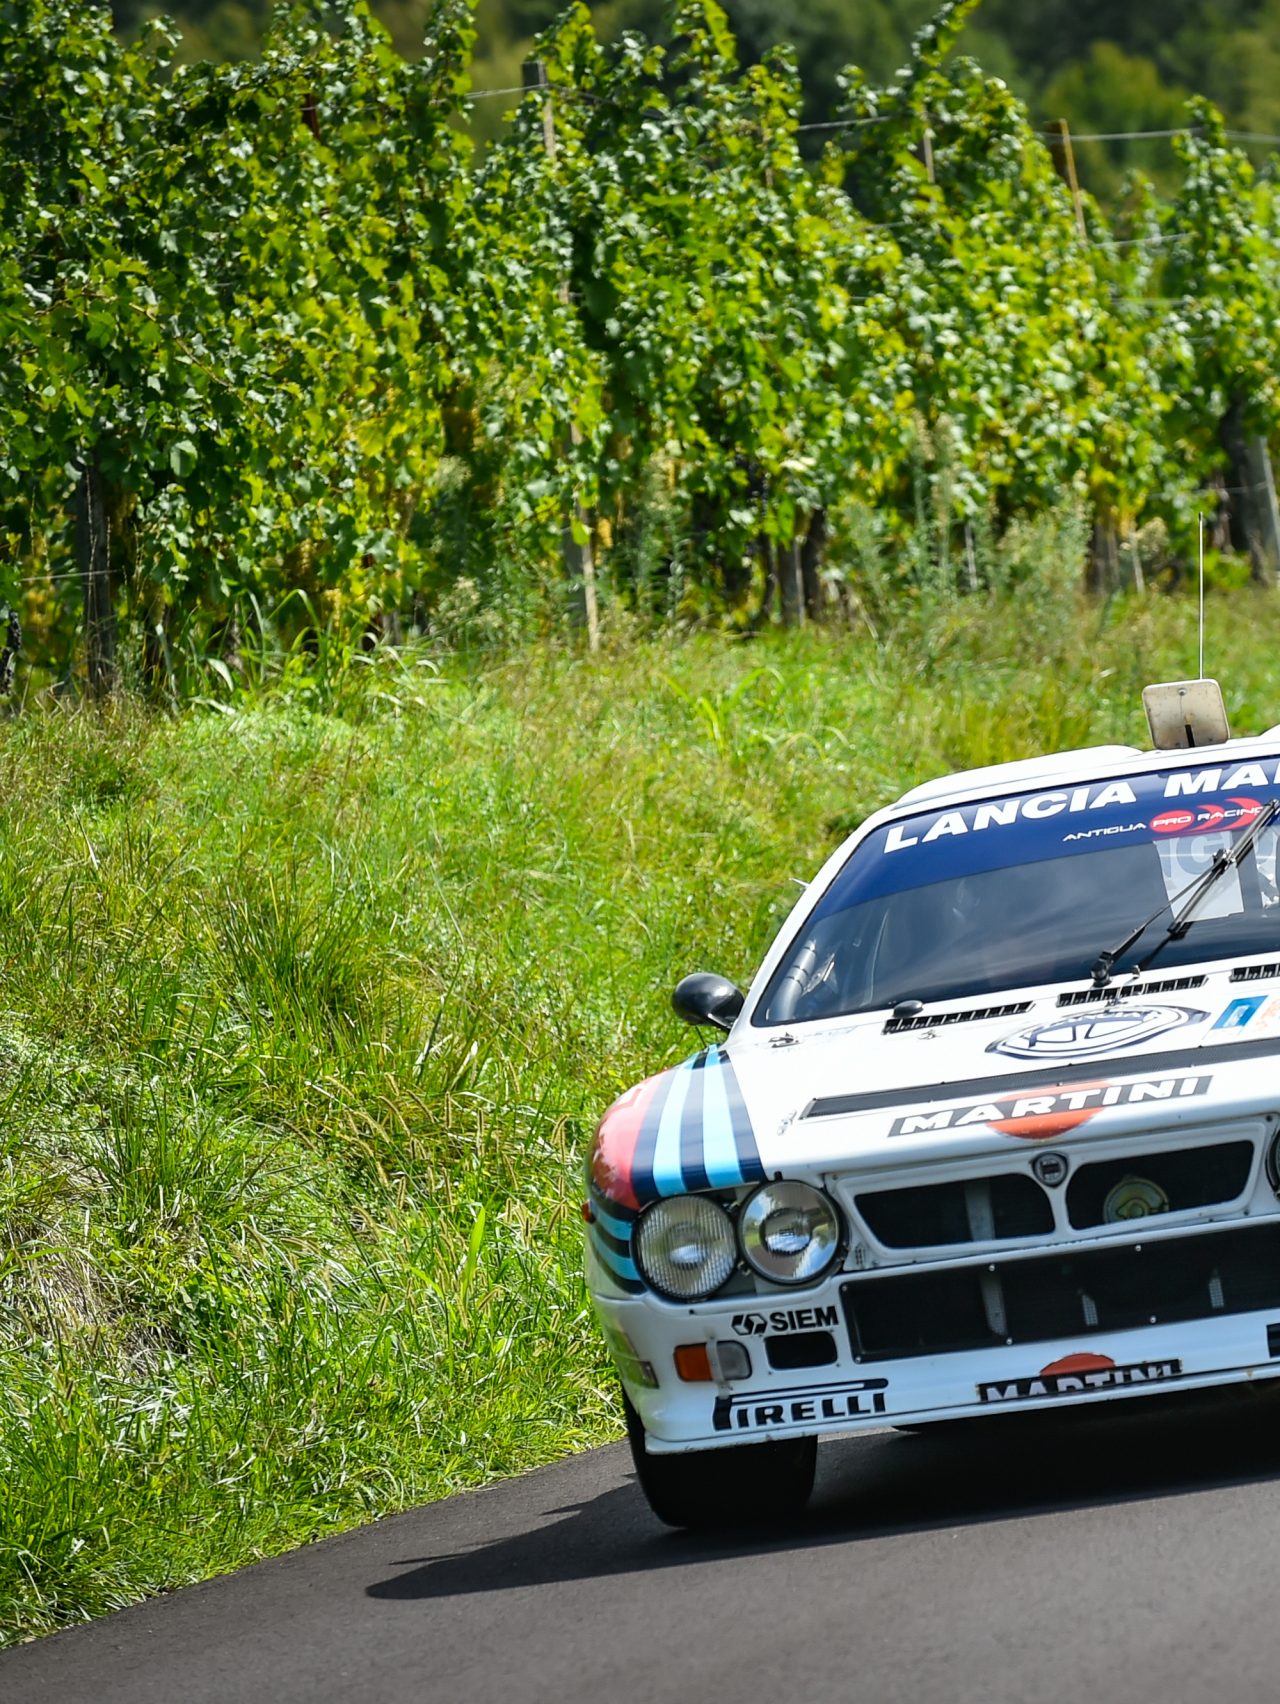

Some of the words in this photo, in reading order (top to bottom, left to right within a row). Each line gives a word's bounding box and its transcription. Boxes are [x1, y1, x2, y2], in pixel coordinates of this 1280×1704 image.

[883, 780, 1137, 854] LANCIA
[1062, 821, 1147, 842] ANTIGUA
[1151, 814, 1193, 828] PRO
[898, 1077, 1201, 1135] MARTINI
[769, 1305, 839, 1332] SIEM
[712, 1378, 889, 1432] PIRELLI
